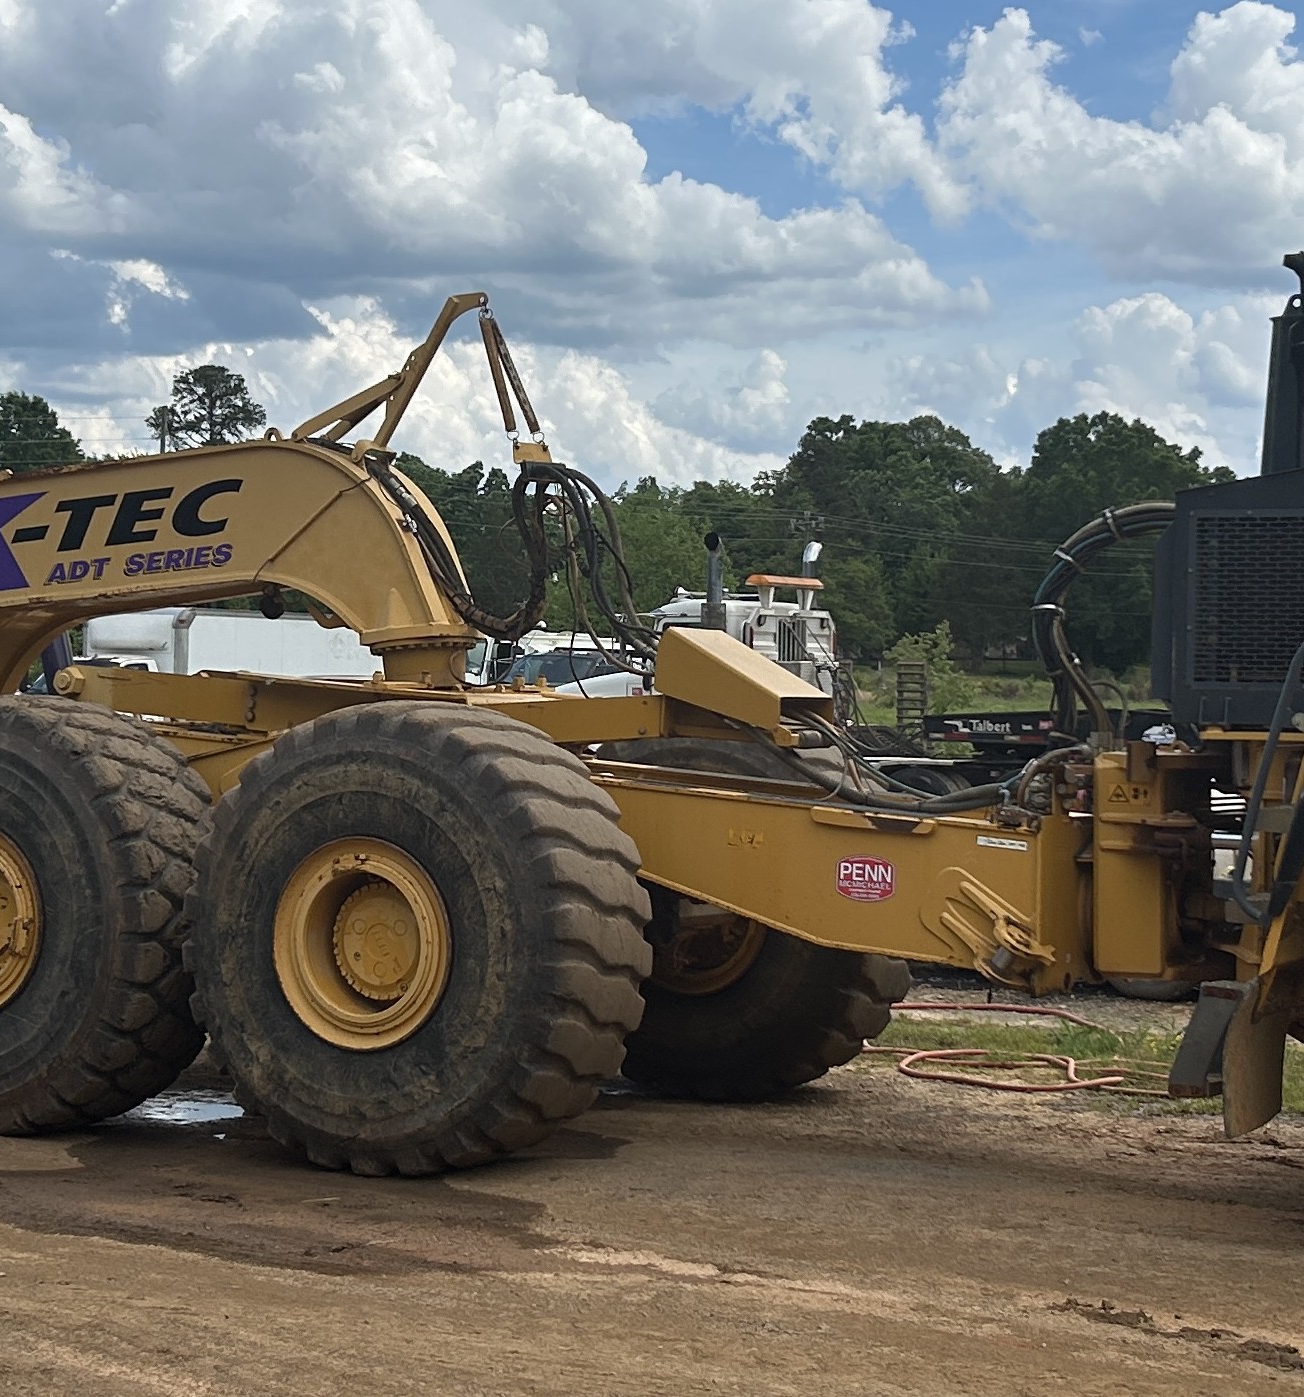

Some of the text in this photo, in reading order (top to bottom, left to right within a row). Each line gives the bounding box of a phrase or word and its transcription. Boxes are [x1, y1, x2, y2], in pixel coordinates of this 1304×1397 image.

[44, 543, 234, 586] ADT SERIES
[968, 719, 1012, 733] Talbert
[839, 862, 892, 883] PENN
